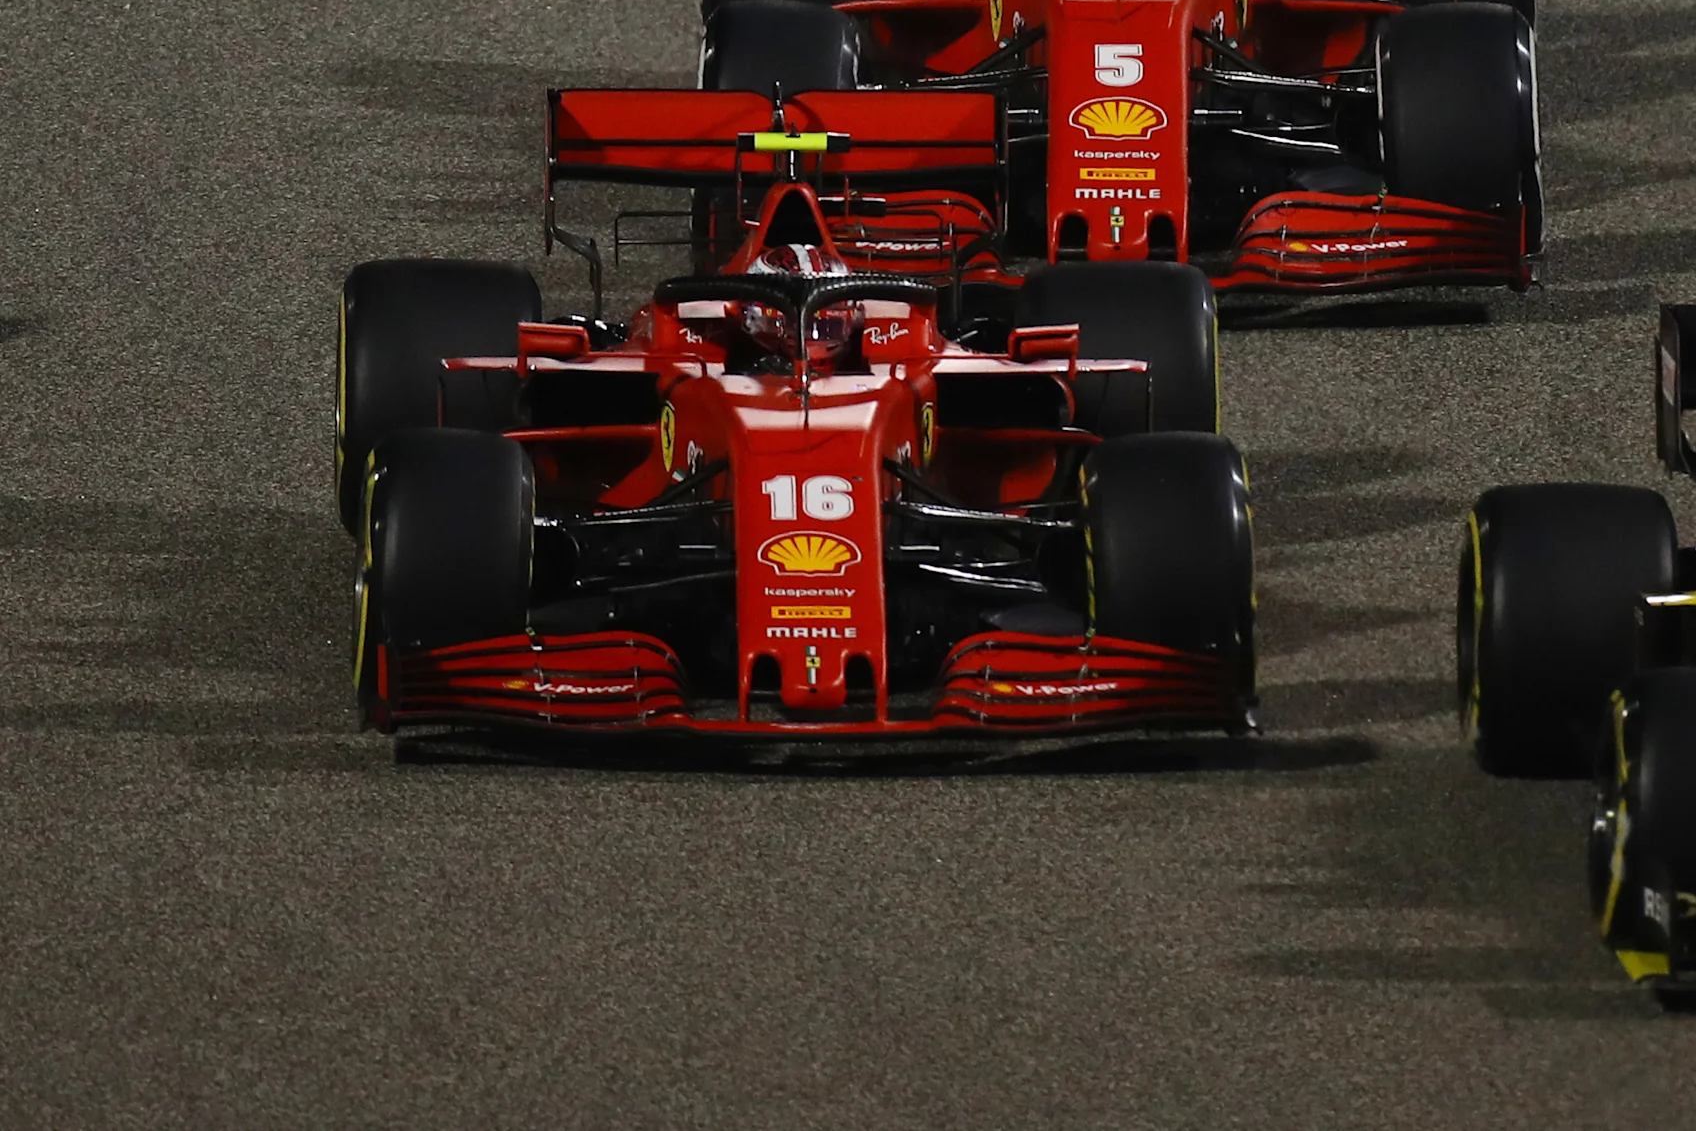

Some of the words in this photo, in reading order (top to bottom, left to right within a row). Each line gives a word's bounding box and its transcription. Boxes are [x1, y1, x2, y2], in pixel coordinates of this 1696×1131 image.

[1094, 43, 1144, 87] 5
[1073, 149, 1160, 160] kaspersky
[1074, 187, 1162, 199] MAHLE
[1310, 239, 1408, 253] V-Power
[761, 475, 855, 521] 16
[764, 587, 856, 598] kaspersky
[766, 626, 857, 638] MAHLE
[533, 682, 634, 694] V-Power
[1015, 682, 1118, 695] V-Power
